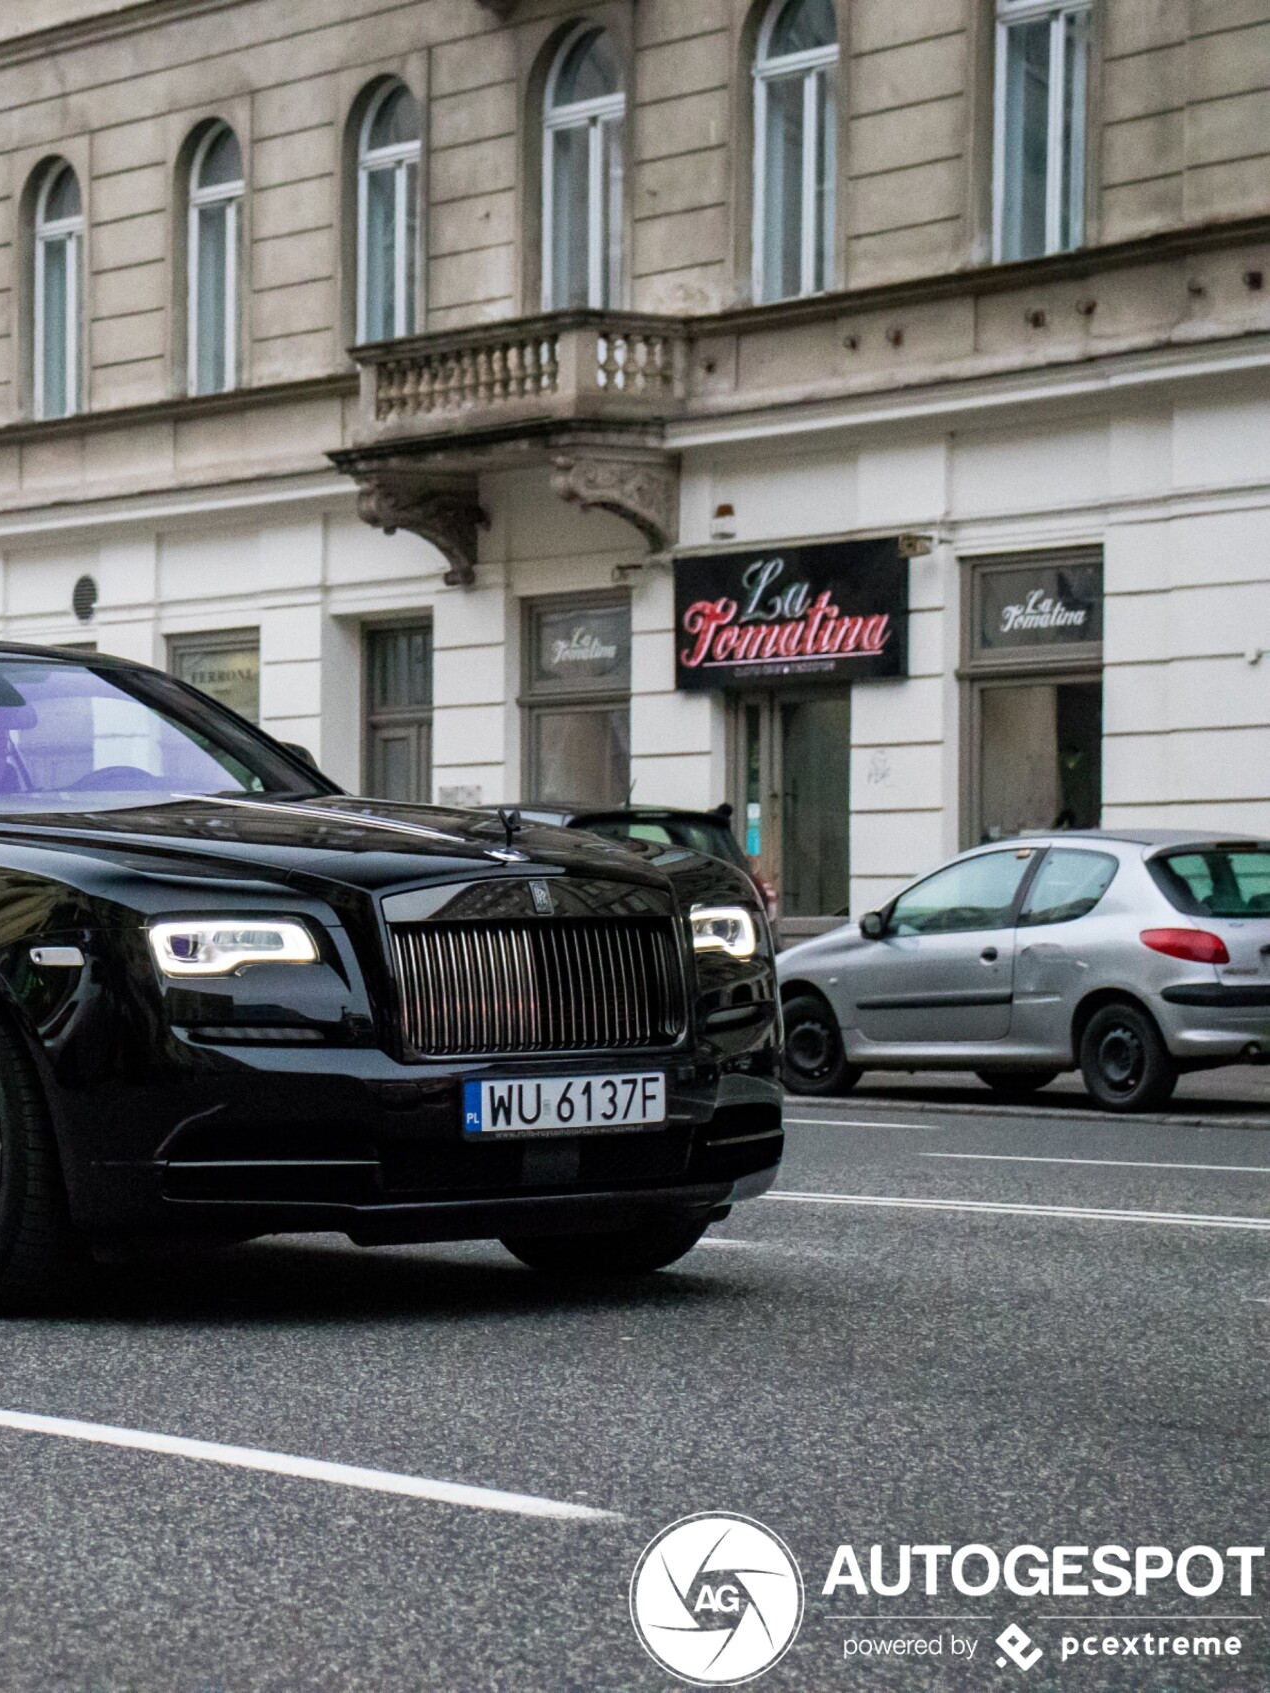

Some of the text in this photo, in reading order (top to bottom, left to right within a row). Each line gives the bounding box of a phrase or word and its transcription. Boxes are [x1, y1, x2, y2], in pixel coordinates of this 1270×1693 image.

[741, 557, 813, 625] La
[1025, 588, 1053, 614] La
[681, 590, 892, 668] Tomatina
[1000, 601, 1087, 632] Tomatina
[466, 1112, 480, 1124] PL
[489, 1076, 660, 1127] WU 6137F
